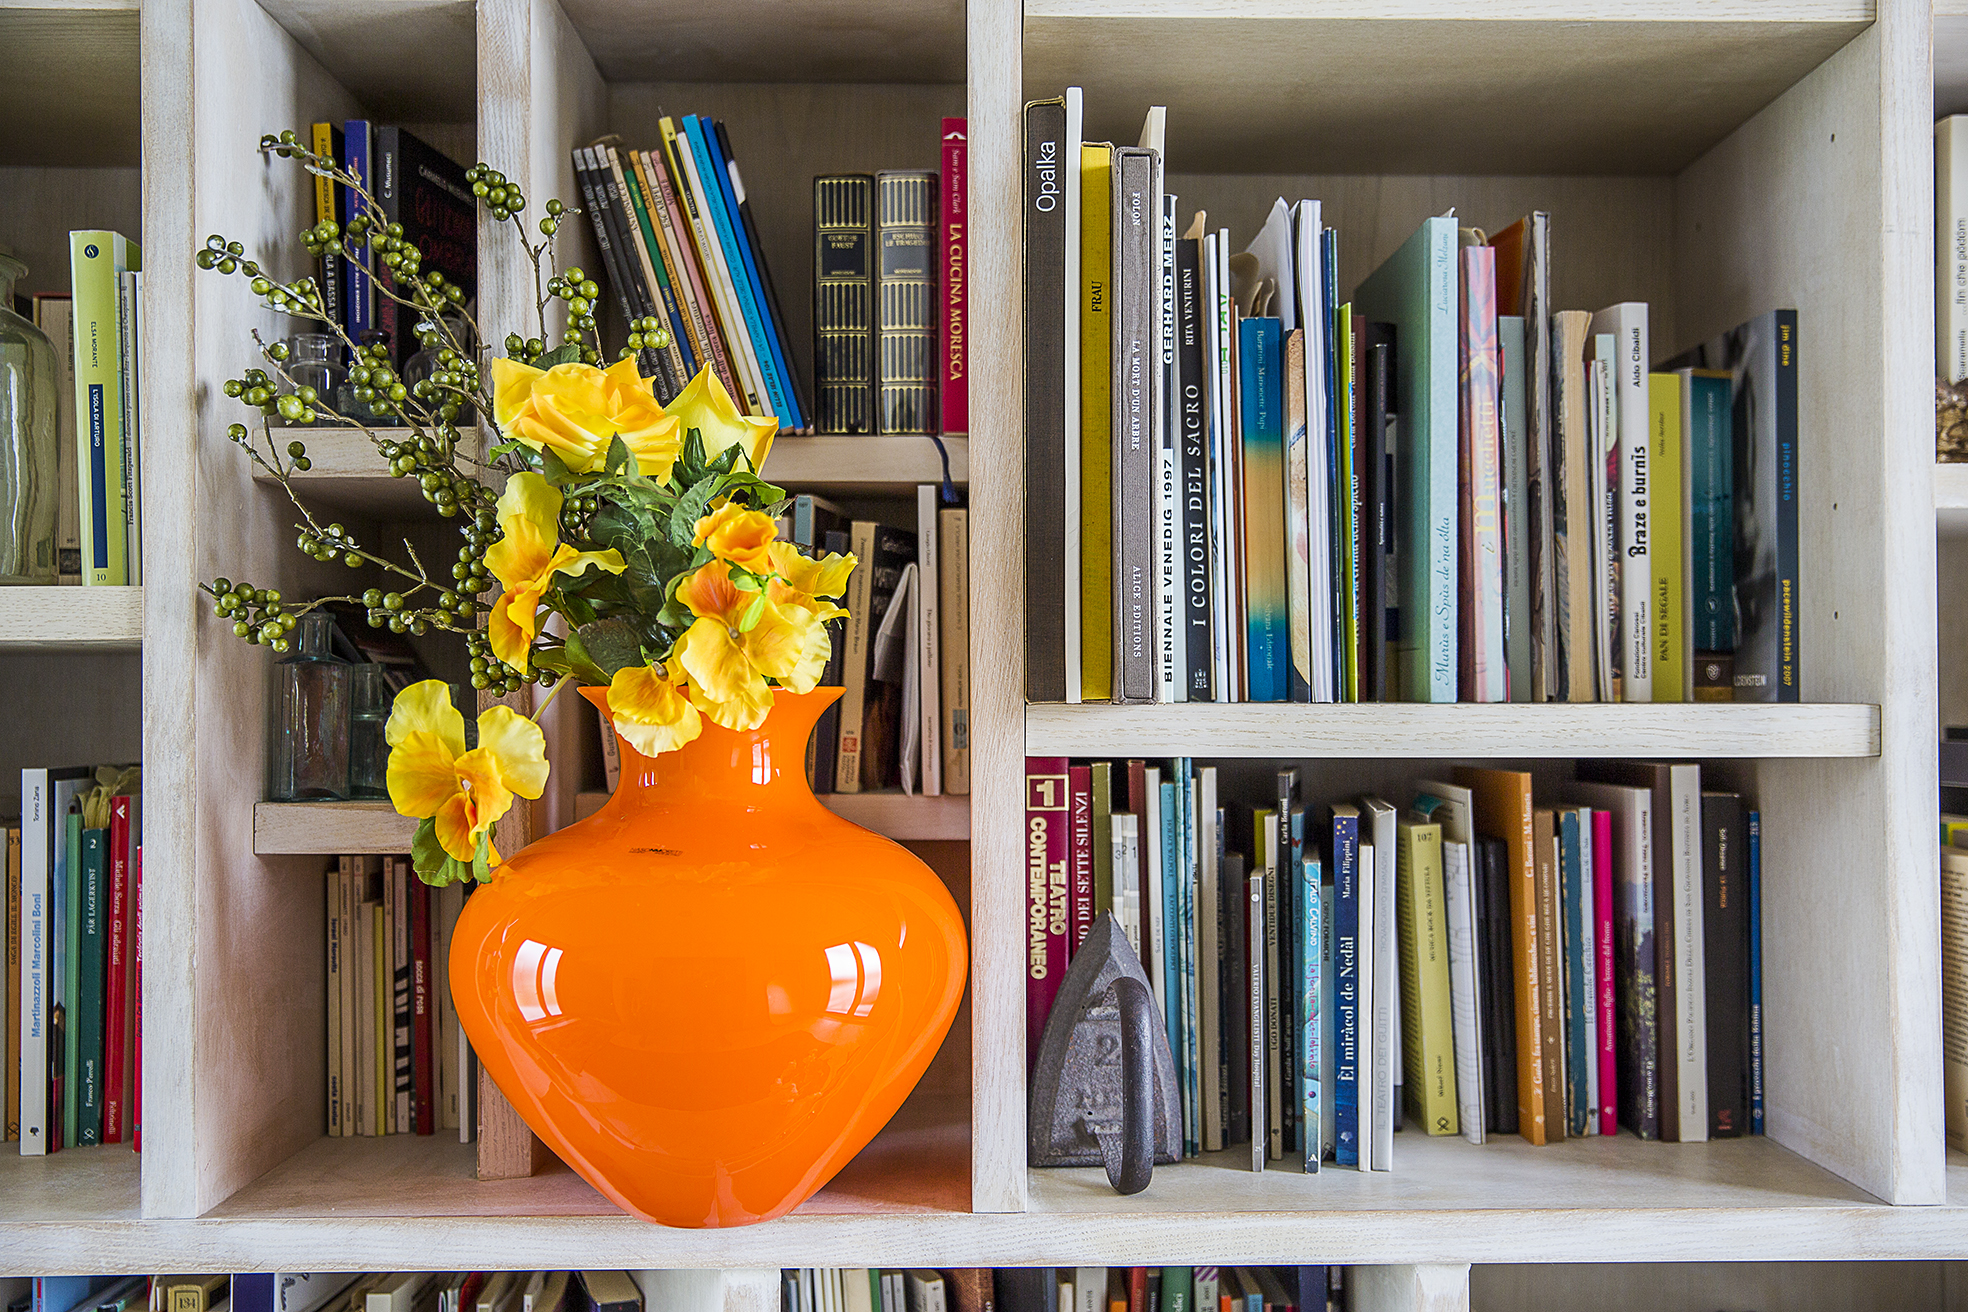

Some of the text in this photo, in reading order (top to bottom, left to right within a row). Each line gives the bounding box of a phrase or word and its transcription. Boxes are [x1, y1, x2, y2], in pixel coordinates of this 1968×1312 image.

[1035, 141, 1060, 212] Opalka
[1132, 192, 1142, 227] FOLON
[830, 241, 855, 249] FAUST
[326, 278, 337, 309] BASSA
[327, 271, 335, 279] A
[1091, 280, 1102, 312] FRAU
[1162, 215, 1174, 365] GERHARD MERZ
[327, 309, 338, 332] VOE
[949, 223, 962, 381] LA CUCINA MORESCA
[1182, 268, 1195, 346] RITA VENTURINI
[1132, 340, 1142, 351] LA
[1630, 326, 1642, 388] Aldo Cibaldi
[1781, 324, 1792, 367] jim dine
[1132, 356, 1142, 386] MORT
[92, 388, 101, 448] L'ISOLA DI ARTURO
[1132, 416, 1142, 450] ARBRE
[1782, 442, 1792, 502] pinocchio
[1185, 384, 1207, 627] I COLORI DEL SACRO
[1634, 499, 1647, 507] e
[1627, 512, 1648, 558] Braze
[96, 573, 107, 582] 10
[1163, 459, 1174, 683] BIENNALE VENEDIG 1997
[1132, 565, 1143, 659] ALICE EDITIONS
[1781, 578, 1792, 662] pacewildenstein
[32, 785, 41, 822] Tonino Zana
[1074, 791, 1090, 846] SILENZI
[89, 838, 97, 849] 2
[114, 859, 124, 891] Michele
[1075, 848, 1091, 894] SETTE
[1341, 838, 1354, 899] Maria Filippini
[88, 866, 97, 918] LAGERKVIST
[113, 891, 122, 915] Serra
[1029, 816, 1048, 980] CONTEMPORANEO
[1049, 859, 1067, 936] TEATRO
[1076, 896, 1091, 921] DEI
[1266, 866, 1277, 947] VENTIDUE DISEGNI
[1308, 878, 1319, 947] ITALO CALVINO
[31, 892, 42, 1038] Martinazzoli Marcolini Boni
[1252, 963, 1260, 994] VALERIO
[1339, 935, 1354, 979] Nedàl
[1339, 982, 1354, 1001] de
[1252, 995, 1261, 1042] EVANGELISTI
[1269, 998, 1278, 1051] UGO DONATI
[1339, 1005, 1355, 1061] miràcol
[1376, 1006, 1388, 1044] GUITTI
[1252, 1058, 1261, 1088] Hospital
[1376, 1047, 1388, 1067] DEI
[1533, 1059, 1543, 1085] Garda
[1376, 1070, 1388, 1116] TEATRO
